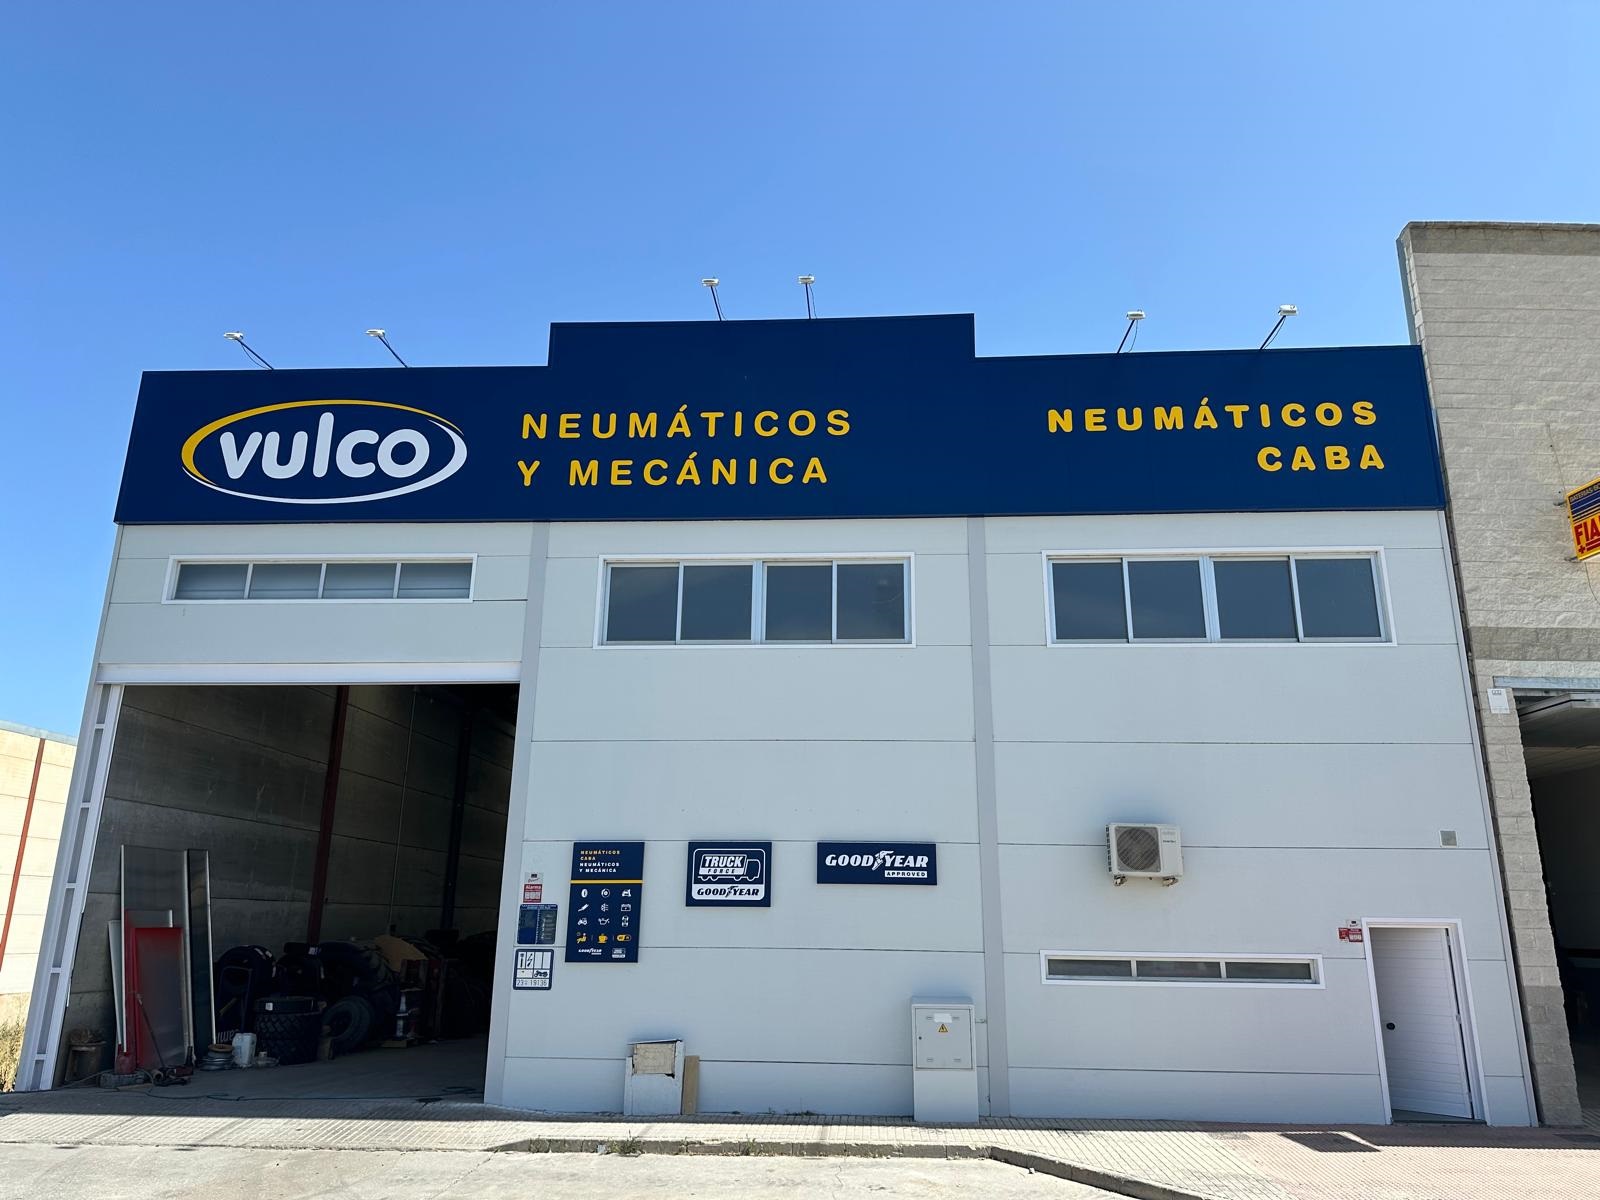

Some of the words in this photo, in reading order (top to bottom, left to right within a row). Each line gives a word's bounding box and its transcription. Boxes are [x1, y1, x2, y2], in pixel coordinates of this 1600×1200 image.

[522, 404, 850, 439] NEUMÁTICOS
[1047, 397, 1377, 433] NEUMÁTICOS
[219, 412, 430, 480] vulco
[1257, 445, 1385, 472] CABA
[517, 460, 540, 486] Y
[569, 451, 828, 486] MECÁNICA
[1574, 515, 1600, 545] FIA
[704, 856, 744, 868] TRUCK
